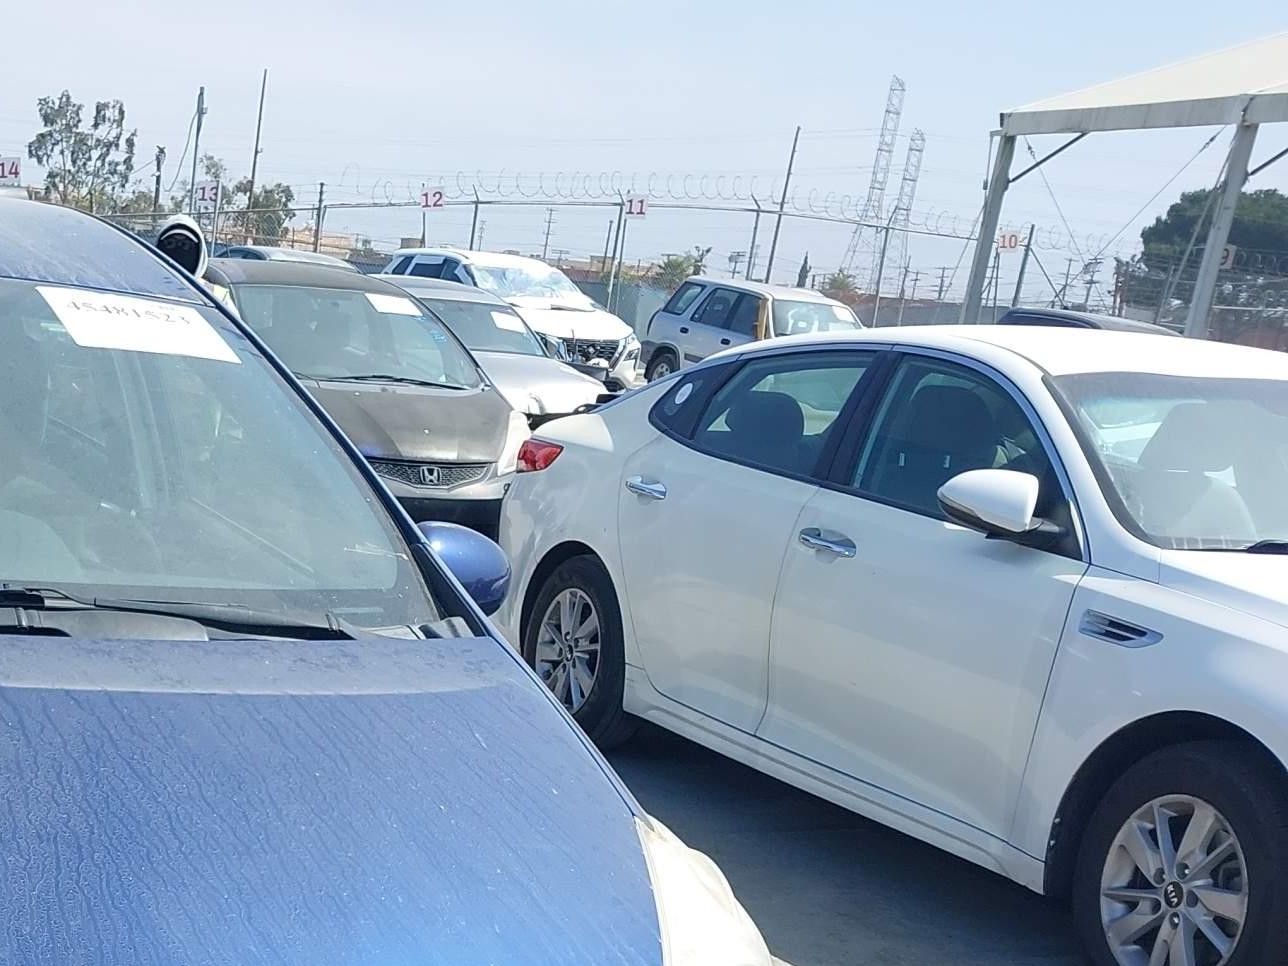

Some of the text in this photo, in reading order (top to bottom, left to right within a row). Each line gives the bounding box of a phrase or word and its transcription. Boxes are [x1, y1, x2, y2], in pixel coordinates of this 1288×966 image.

[198, 186, 218, 202] 13
[421, 191, 443, 208] 12
[625, 199, 646, 215] 11
[1000, 234, 1018, 249] 10
